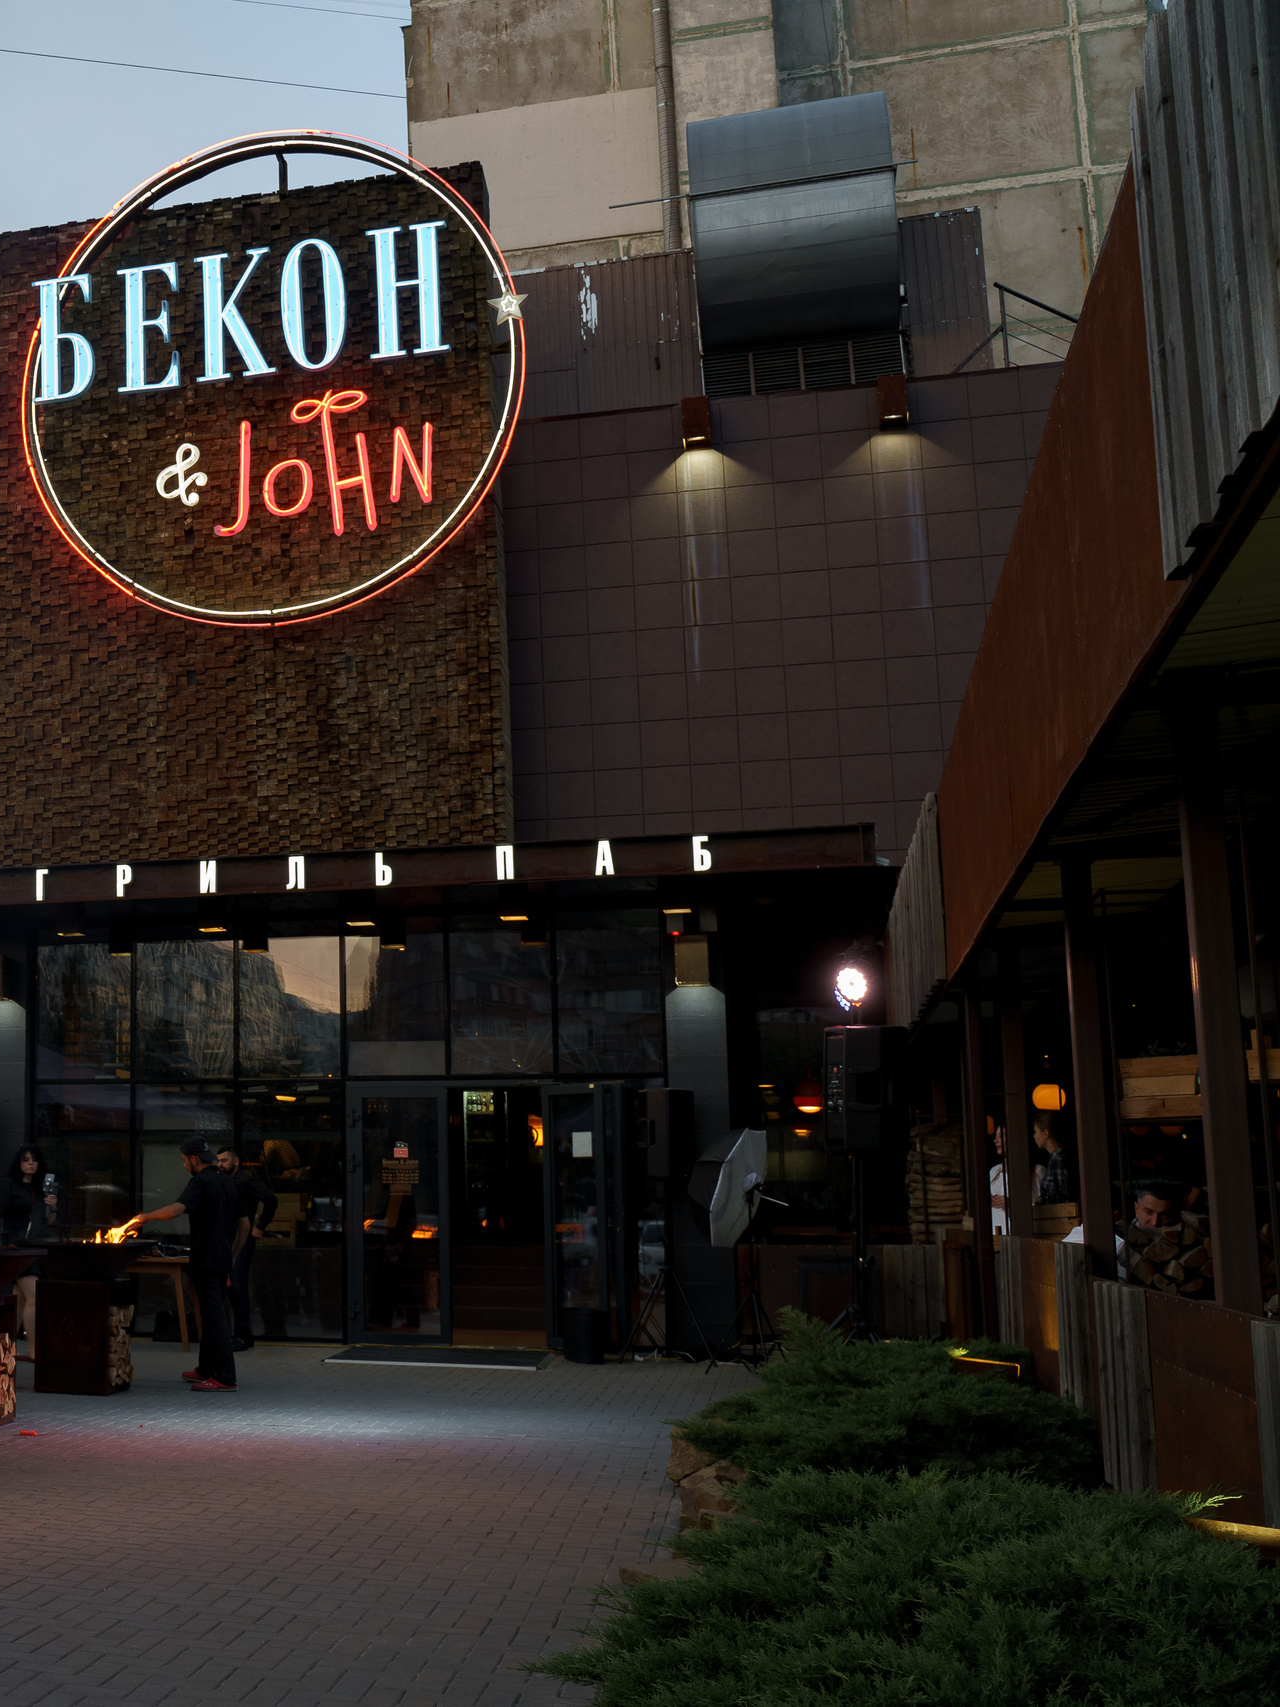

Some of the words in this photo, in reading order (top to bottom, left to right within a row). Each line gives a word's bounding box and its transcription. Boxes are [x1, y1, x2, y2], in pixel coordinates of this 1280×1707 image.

[31, 220, 451, 403] БЕКОН
[156, 443, 208, 506] &
[35, 851, 393, 901] ГРИЛЬ
[495, 835, 713, 880] ПАБ
